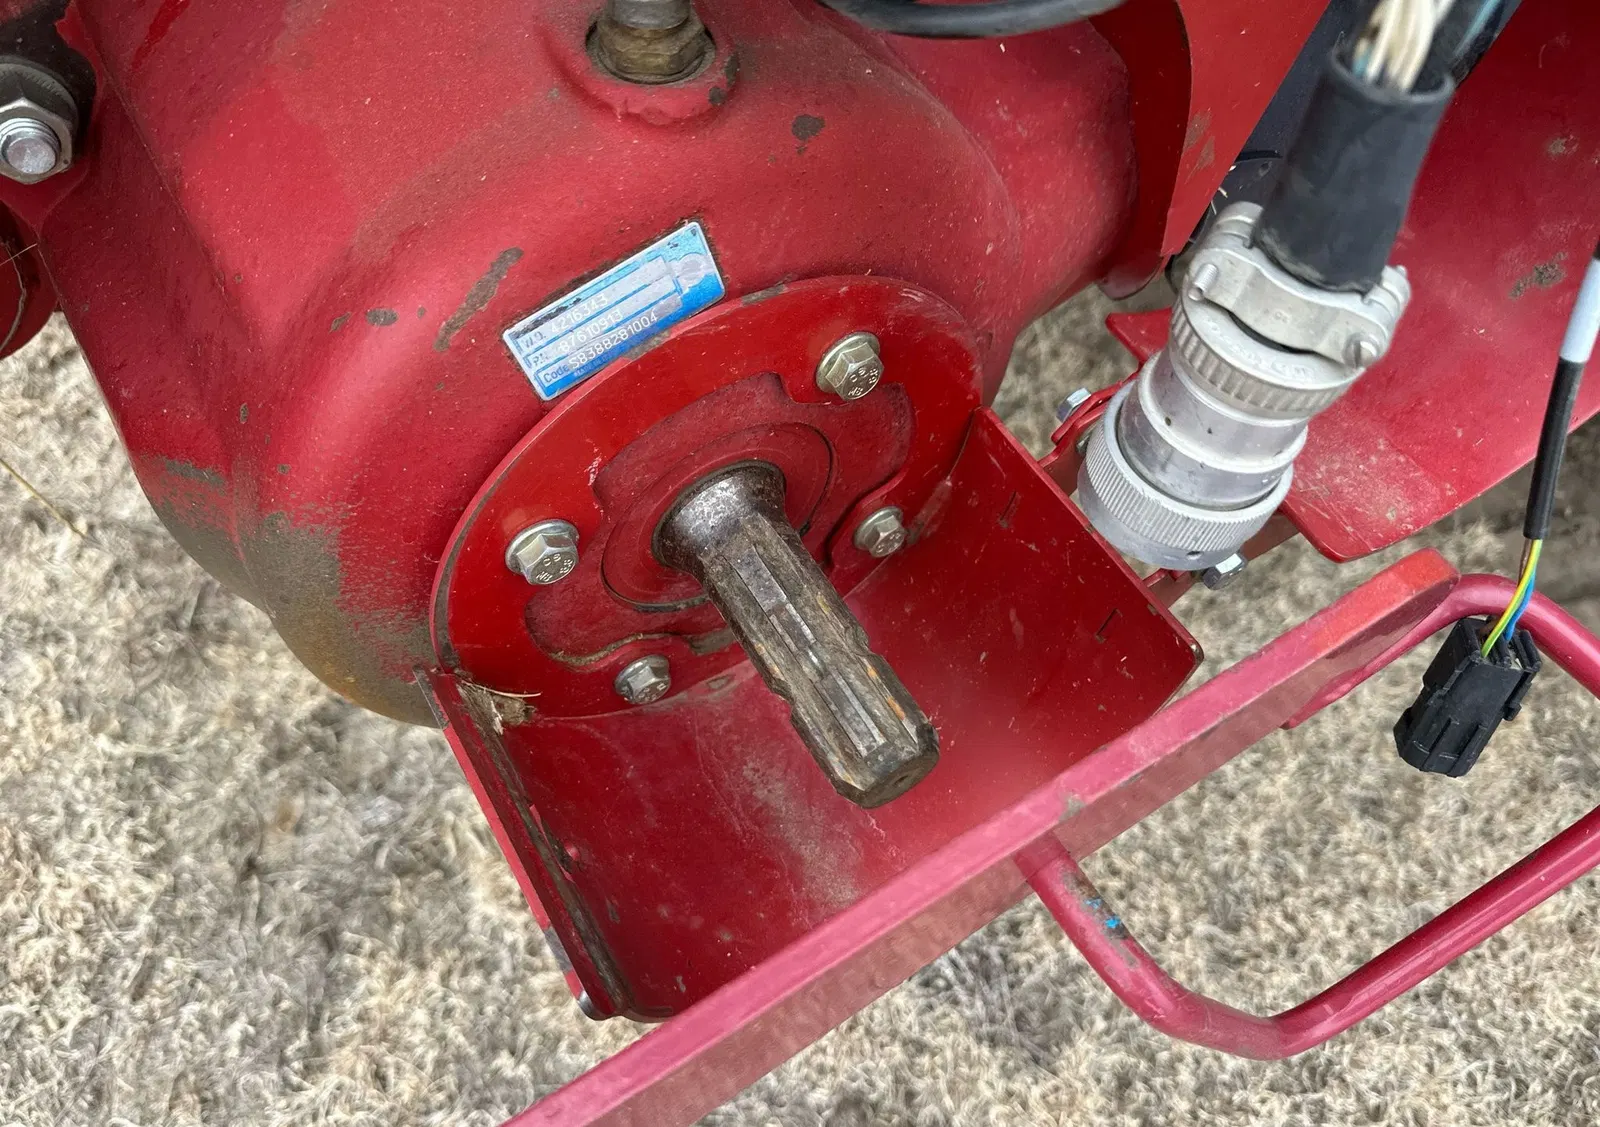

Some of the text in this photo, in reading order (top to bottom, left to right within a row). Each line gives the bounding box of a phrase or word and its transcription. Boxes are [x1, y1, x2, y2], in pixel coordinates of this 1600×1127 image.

[543, 311, 658, 383] Code S8388281004
[559, 308, 623, 353] 87610913
